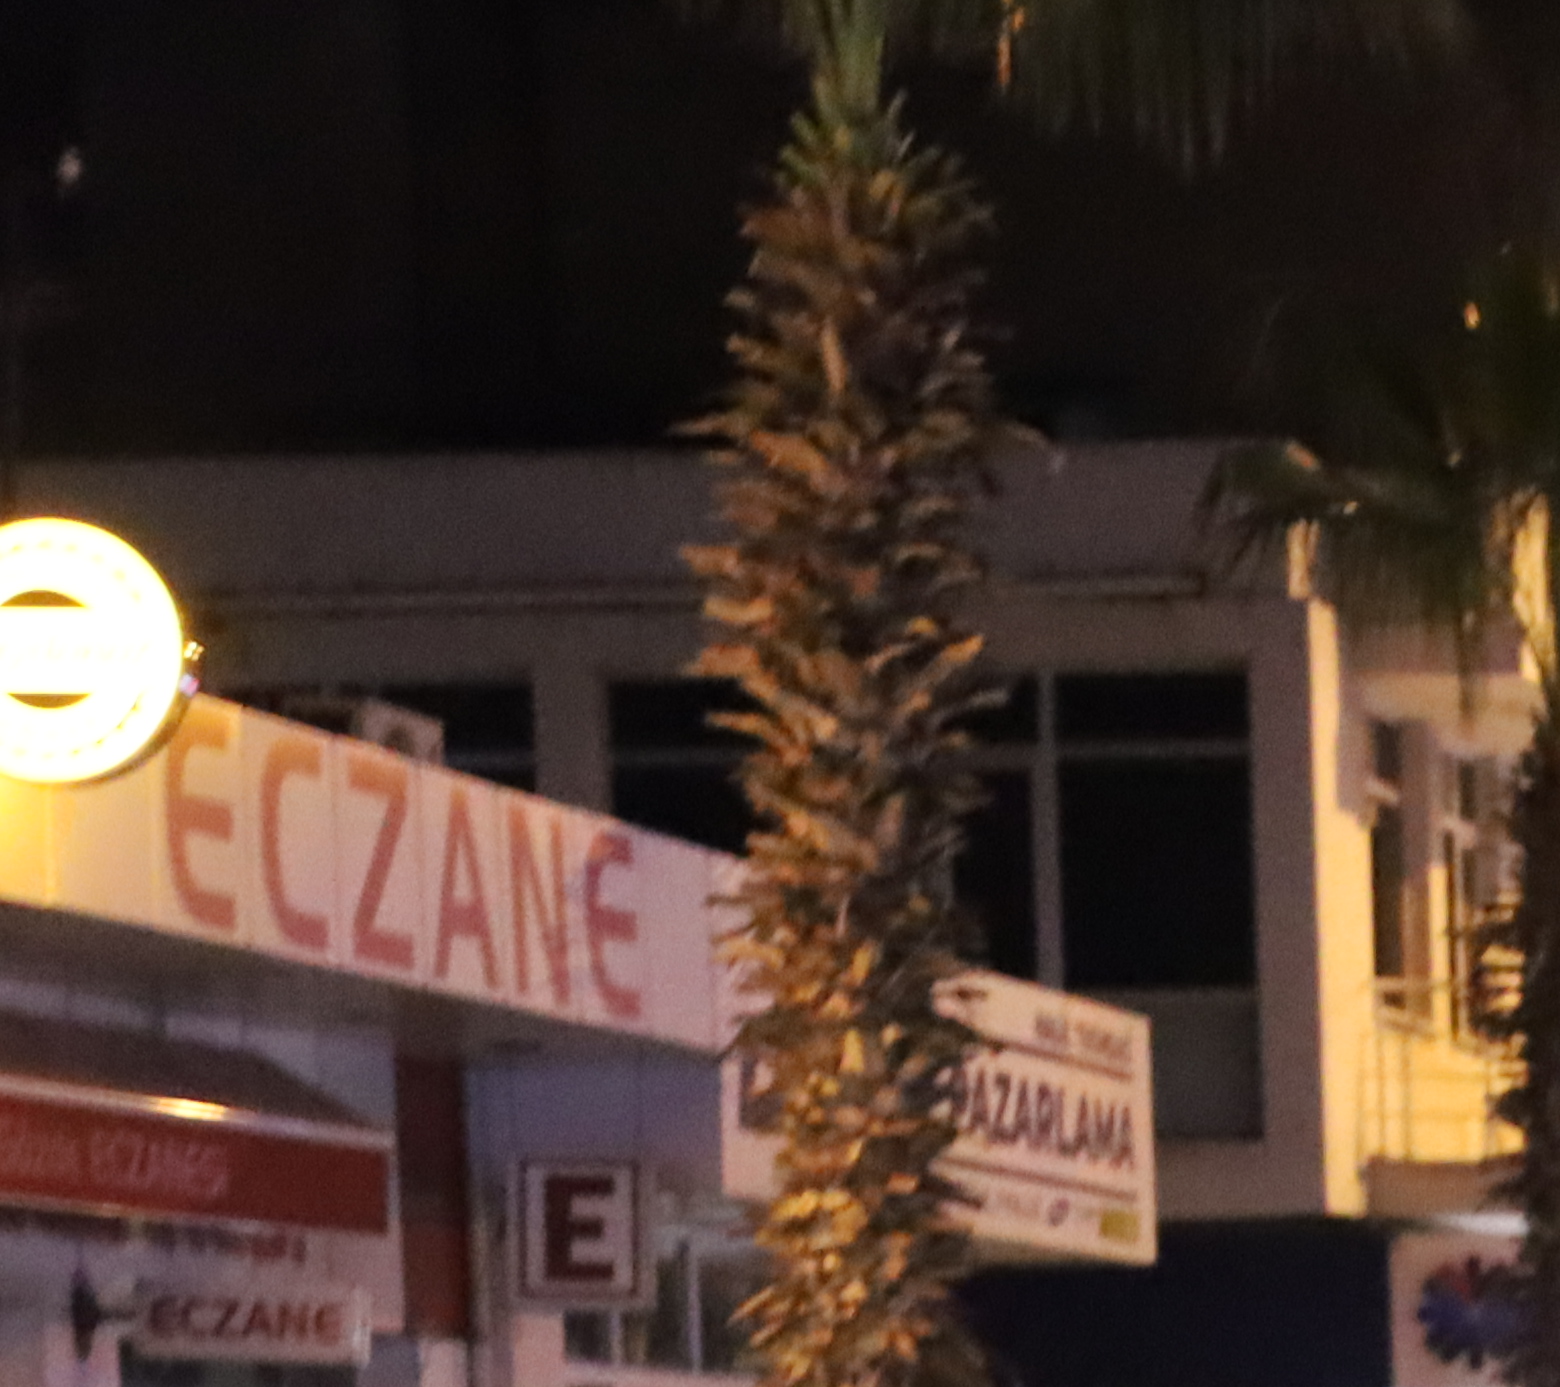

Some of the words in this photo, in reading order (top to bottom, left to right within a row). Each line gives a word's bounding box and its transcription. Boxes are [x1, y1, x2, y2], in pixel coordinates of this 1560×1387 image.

[166, 708, 642, 1018] ECZANE
[544, 1176, 618, 1281] E
[147, 1297, 346, 1347] ECZANE
